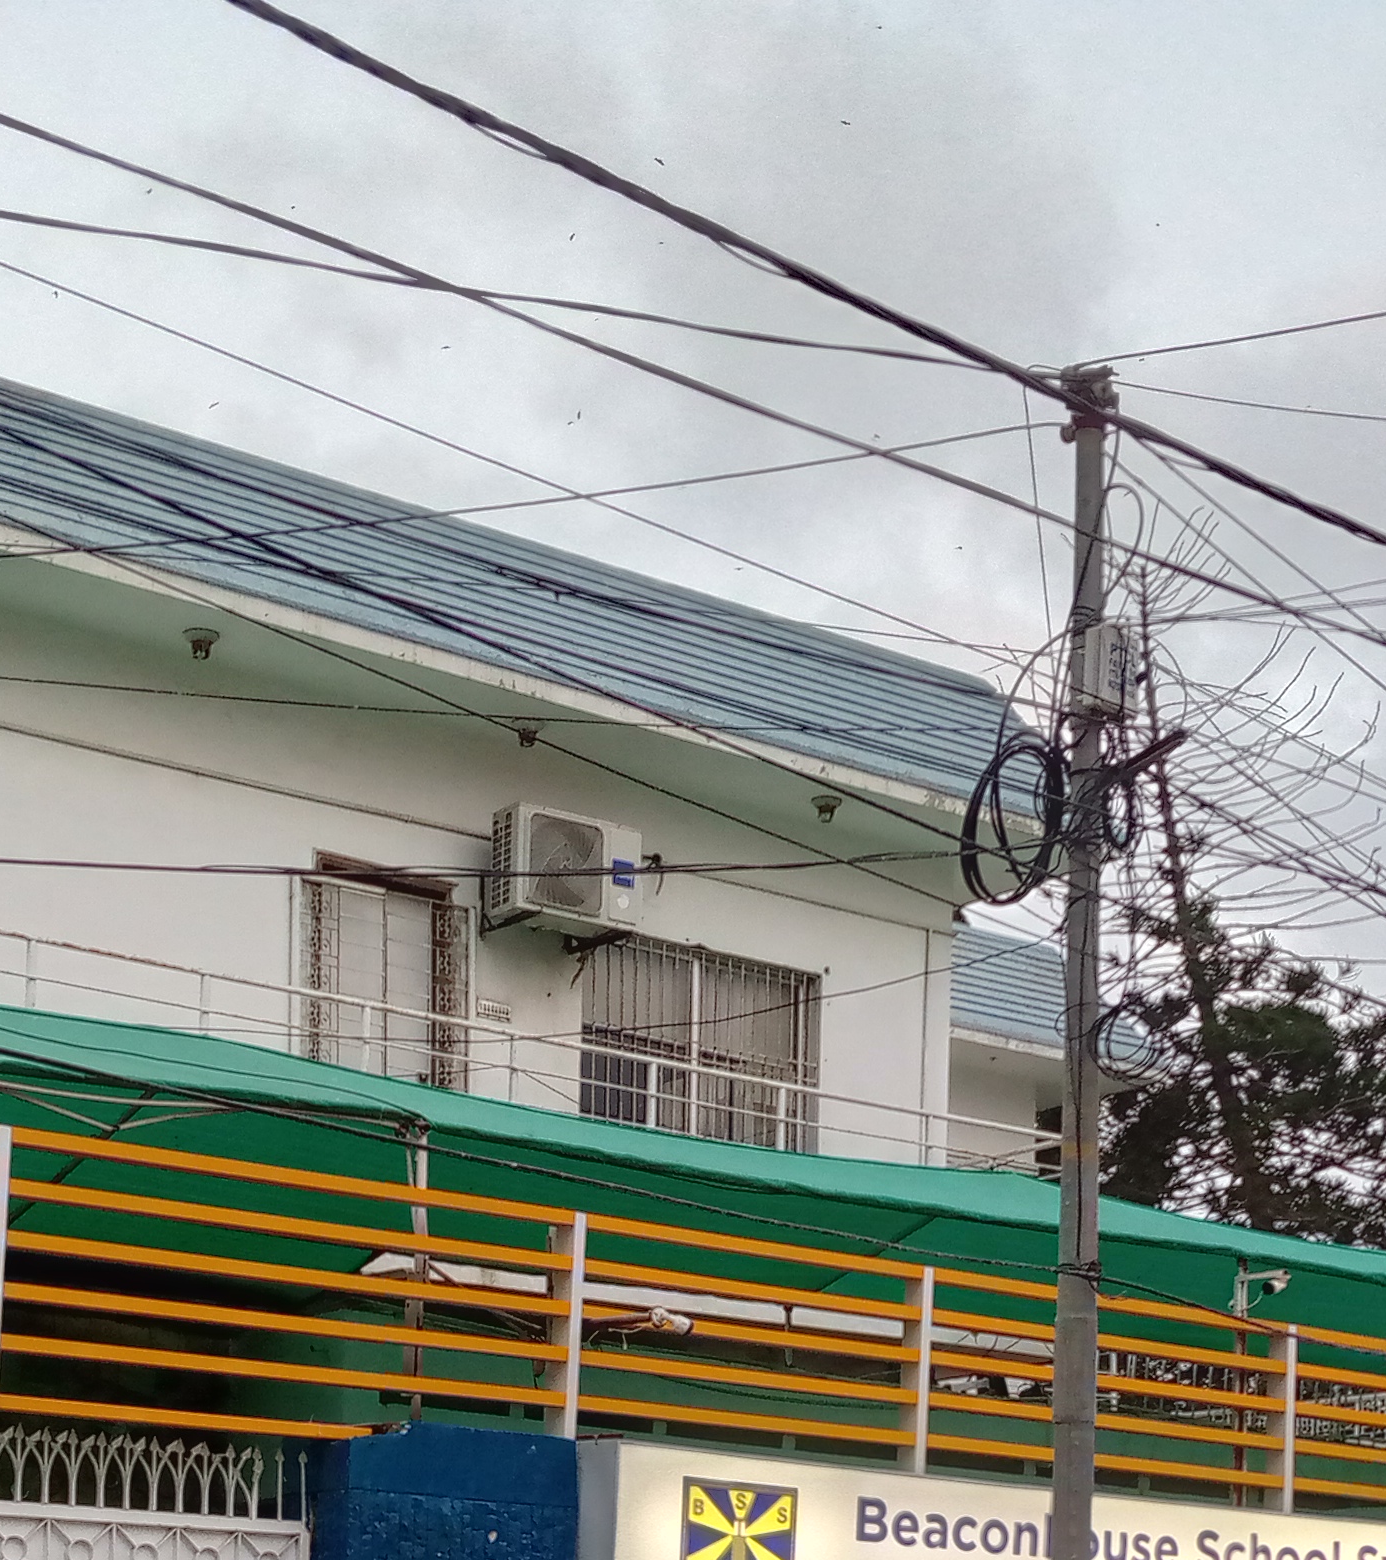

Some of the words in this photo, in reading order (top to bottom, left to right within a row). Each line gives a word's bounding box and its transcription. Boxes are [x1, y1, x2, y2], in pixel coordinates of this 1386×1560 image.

[692, 1498, 705, 1516] B
[735, 1493, 747, 1510] S
[776, 1506, 788, 1524] S
